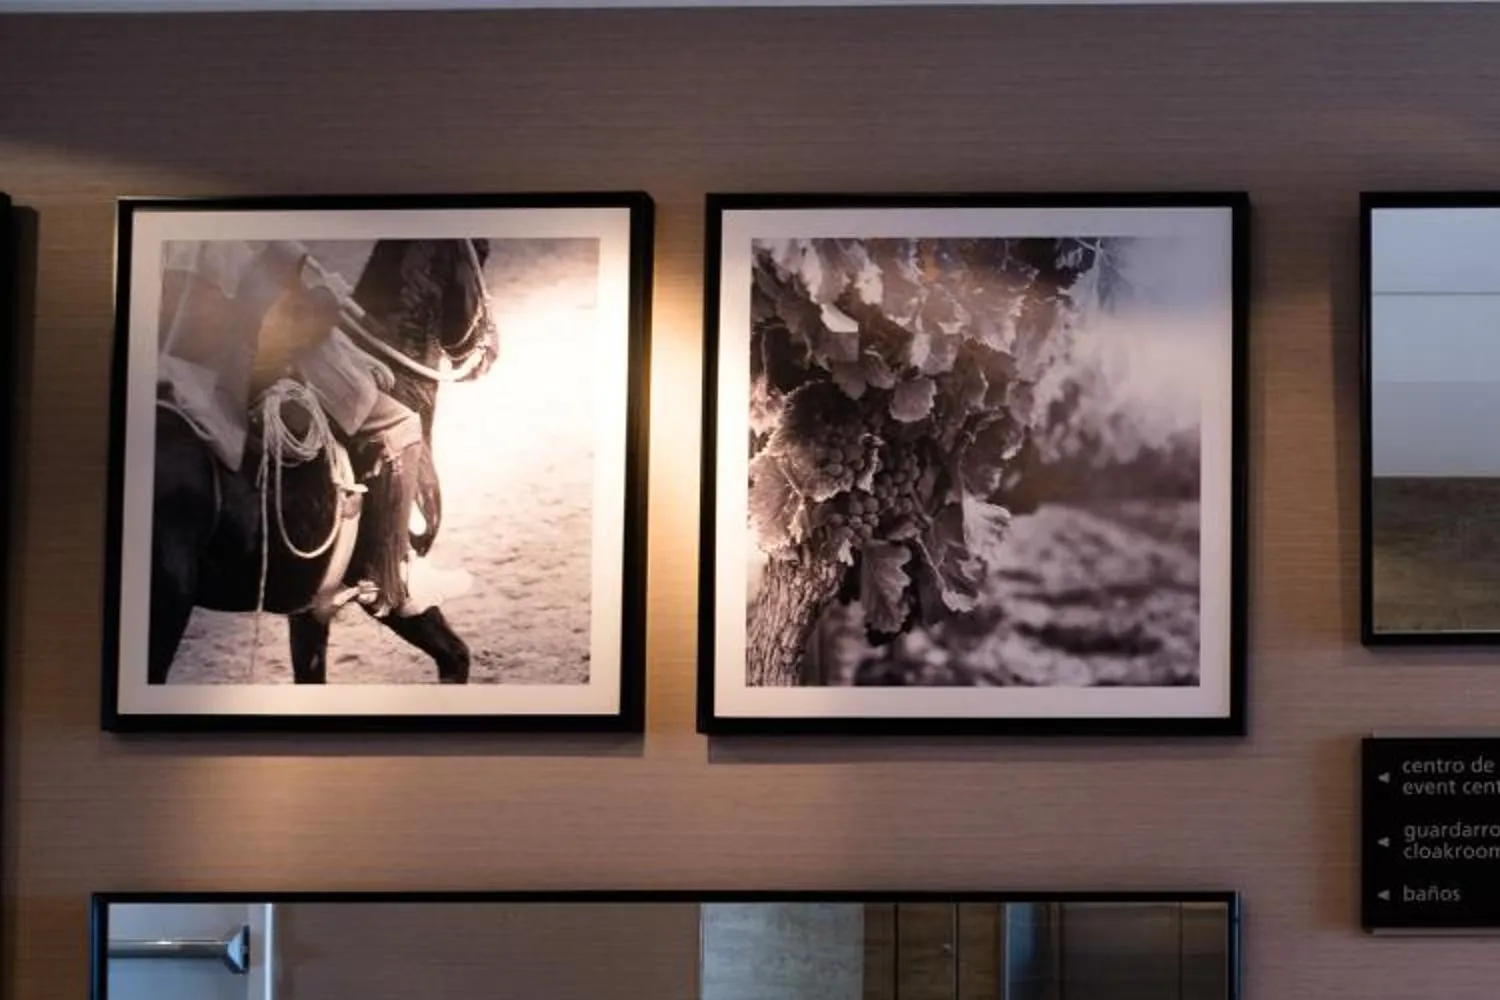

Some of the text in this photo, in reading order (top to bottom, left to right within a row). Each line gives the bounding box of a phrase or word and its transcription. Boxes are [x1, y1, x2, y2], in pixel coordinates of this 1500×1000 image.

[1402, 758, 1465, 774] centro
[1471, 755, 1495, 774] de
[1402, 781, 1456, 795] event
[1402, 884, 1462, 901] baños
